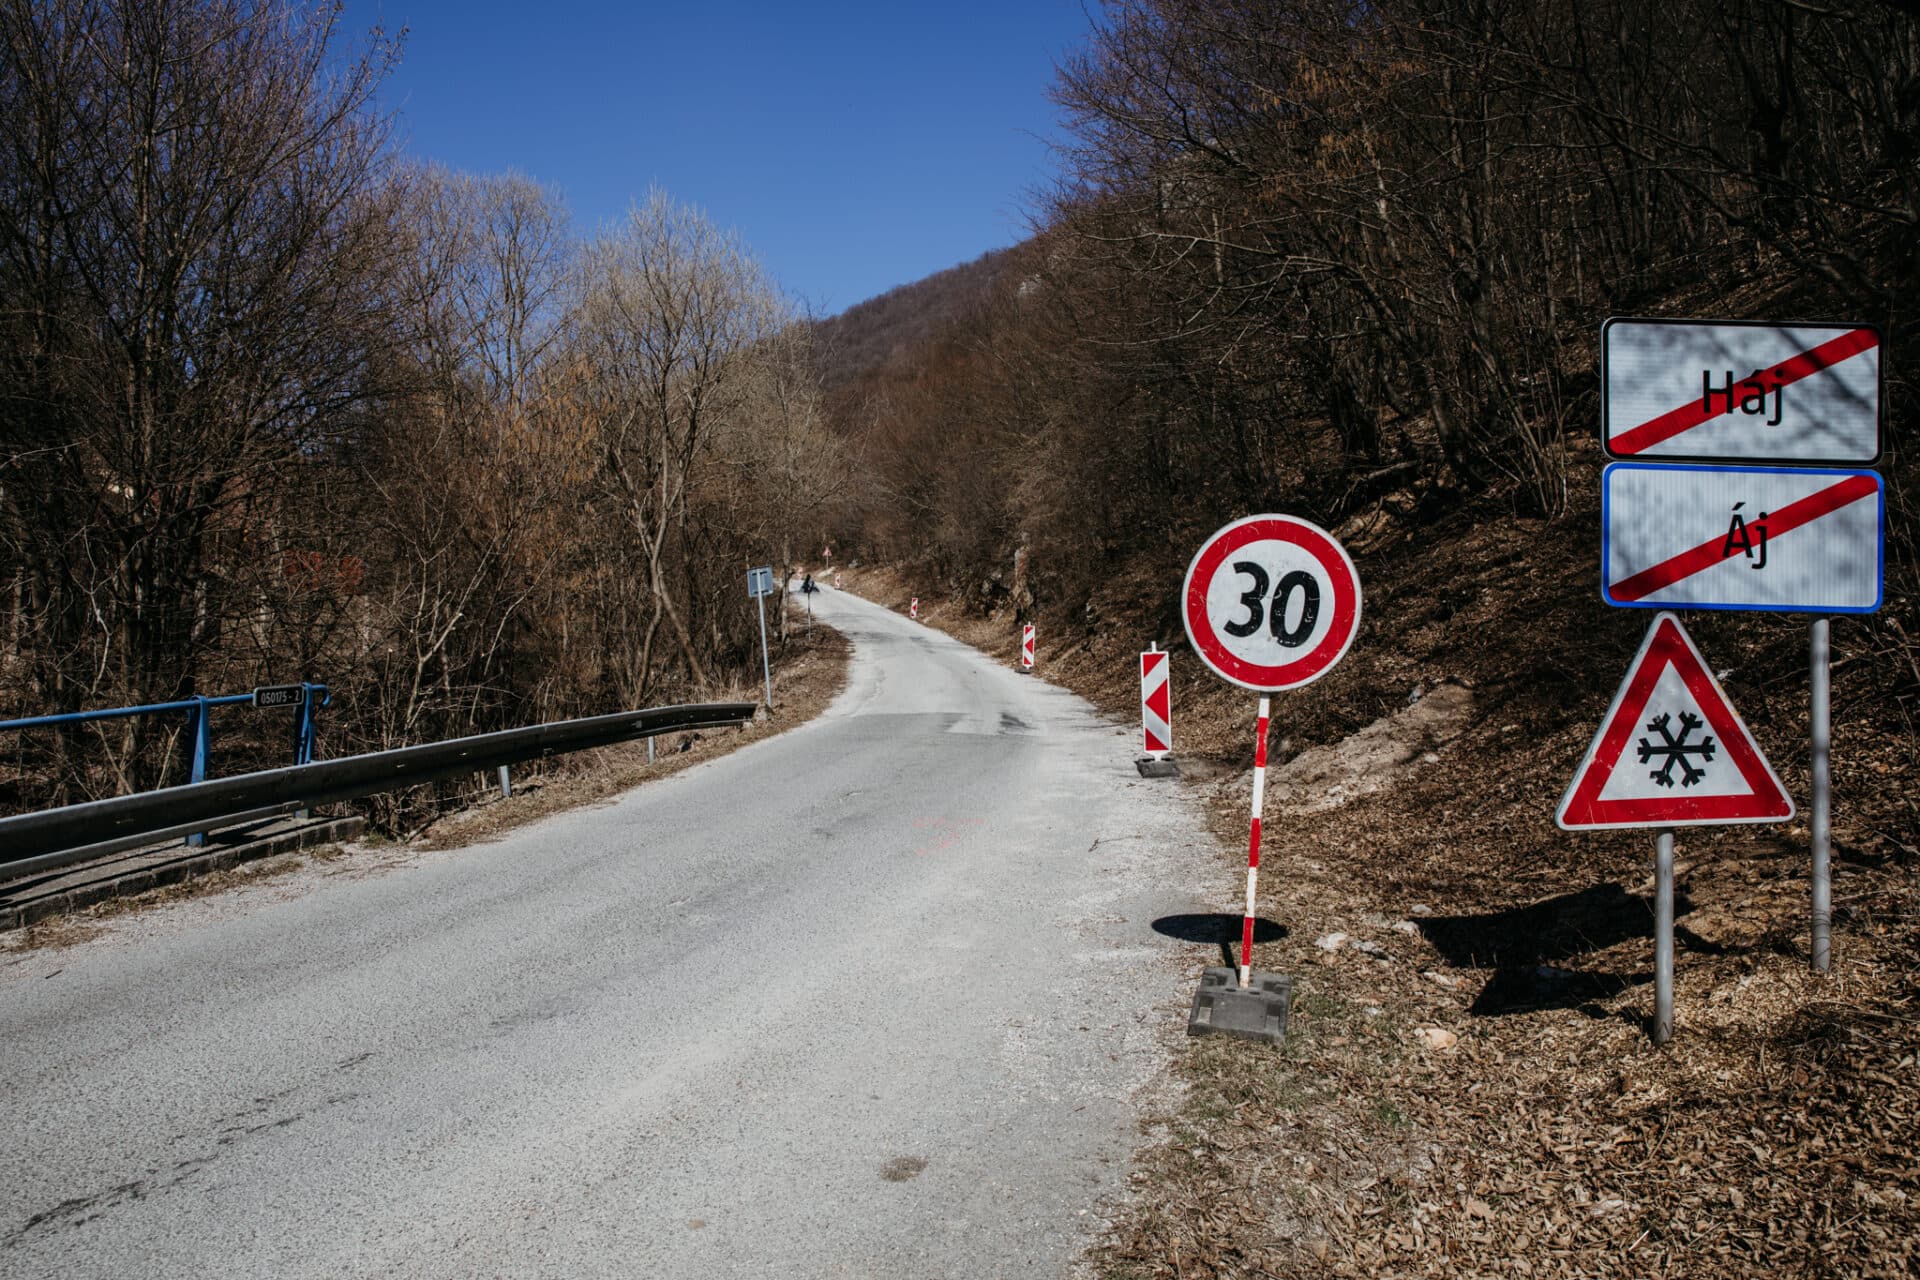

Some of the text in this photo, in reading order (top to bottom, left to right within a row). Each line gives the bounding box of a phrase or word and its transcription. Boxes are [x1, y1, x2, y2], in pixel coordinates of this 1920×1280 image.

[1702, 369, 1784, 426] Háj
[1722, 502, 1768, 569] Áj
[1223, 561, 1320, 648] 30
